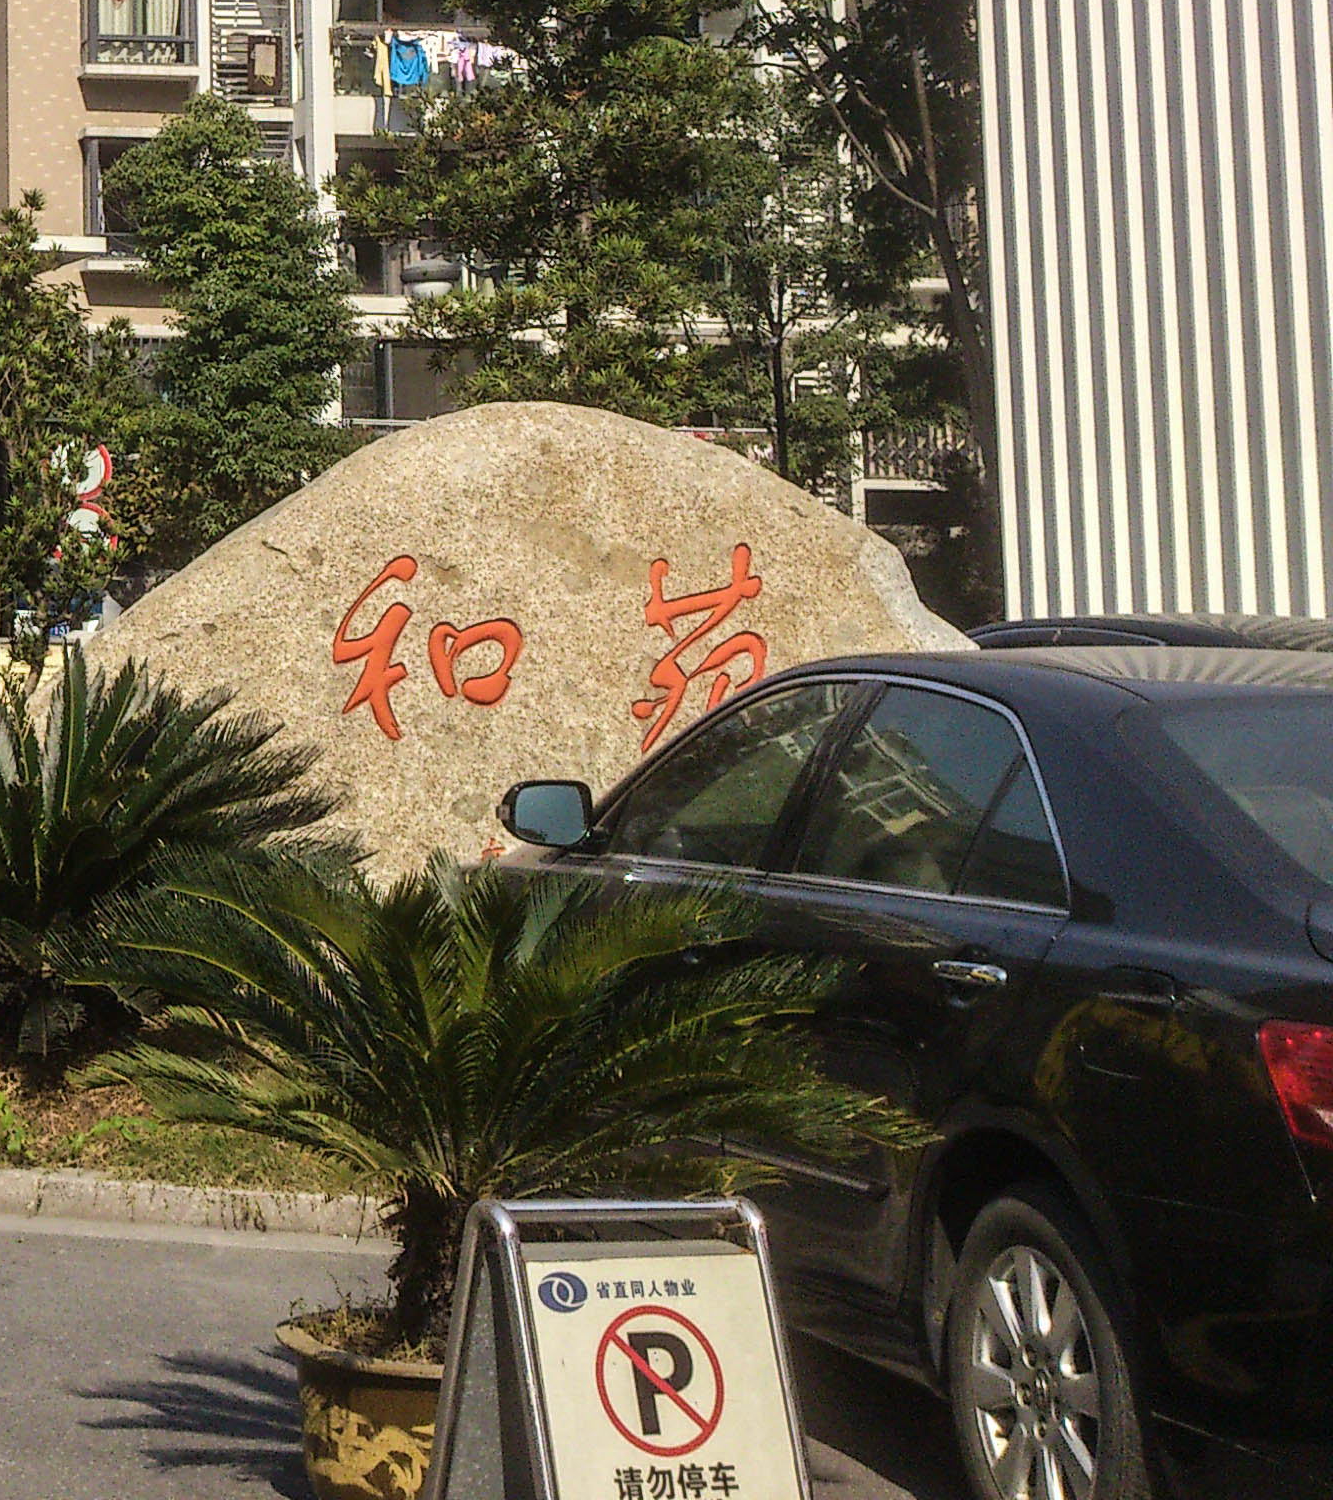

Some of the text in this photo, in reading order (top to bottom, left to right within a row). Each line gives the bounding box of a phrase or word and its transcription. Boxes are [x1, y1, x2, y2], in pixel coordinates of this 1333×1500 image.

[596, 1277, 698, 1300] 省直同人物业
[626, 1330, 694, 1436] P
[613, 1461, 740, 1500] 请勿停车
